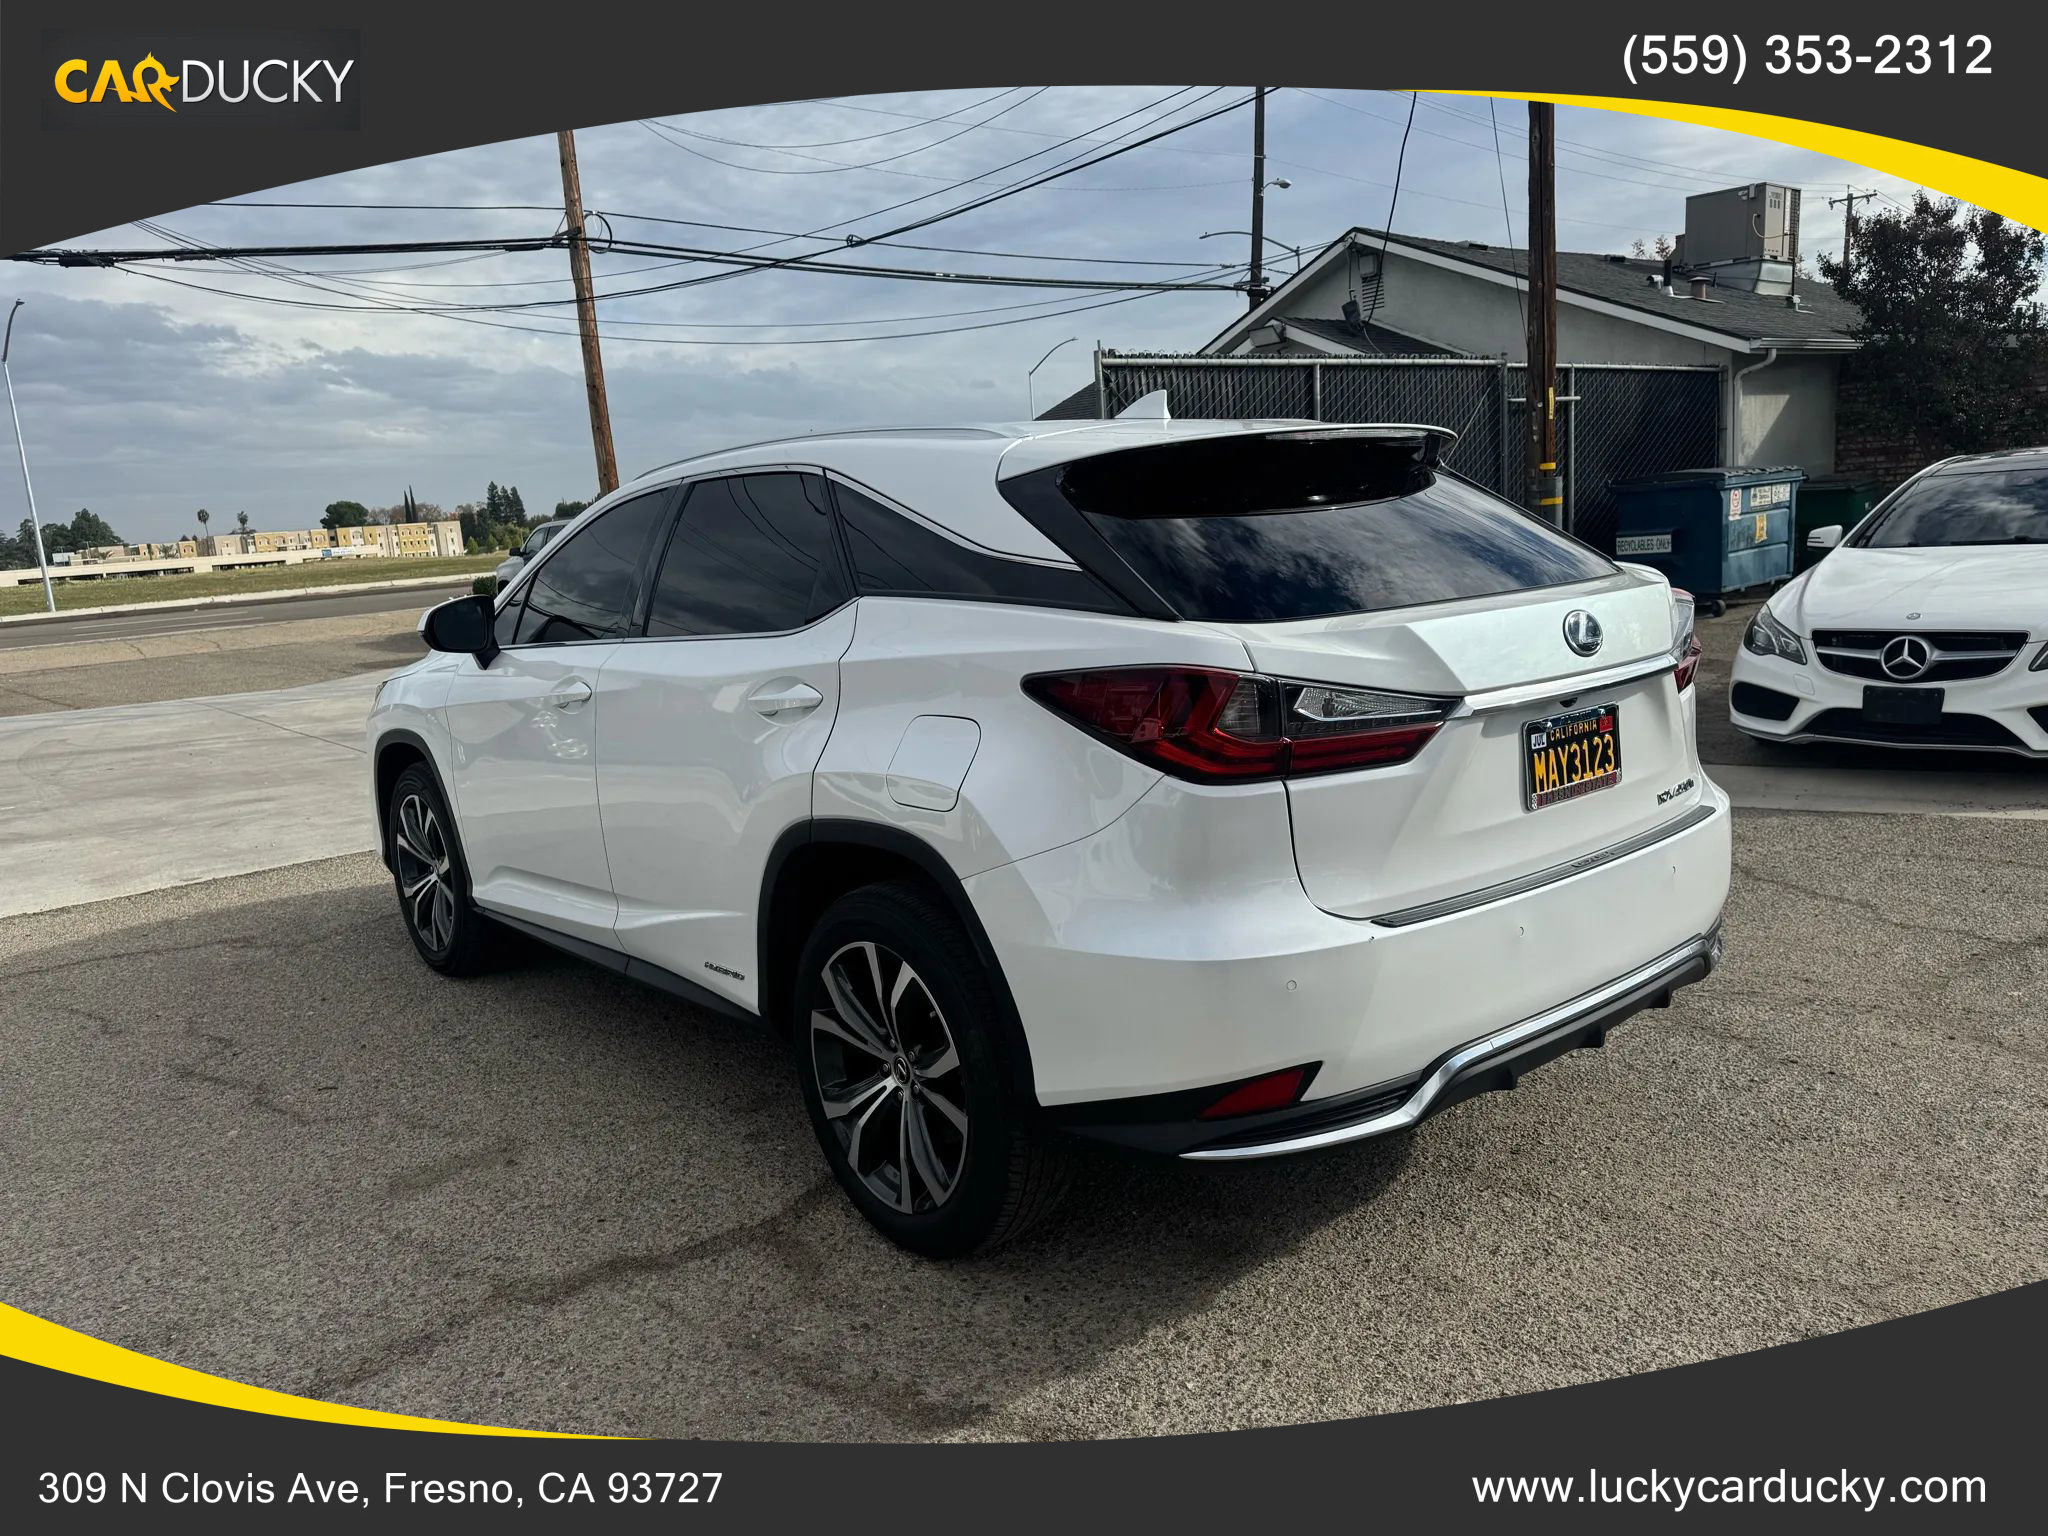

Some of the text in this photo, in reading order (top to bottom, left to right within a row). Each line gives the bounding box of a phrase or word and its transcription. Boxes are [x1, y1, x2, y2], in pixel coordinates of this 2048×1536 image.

[1533, 734, 1546, 748] JUL
[1550, 719, 1598, 741] CALIFORNIA
[1534, 733, 1615, 794] MAY3123
